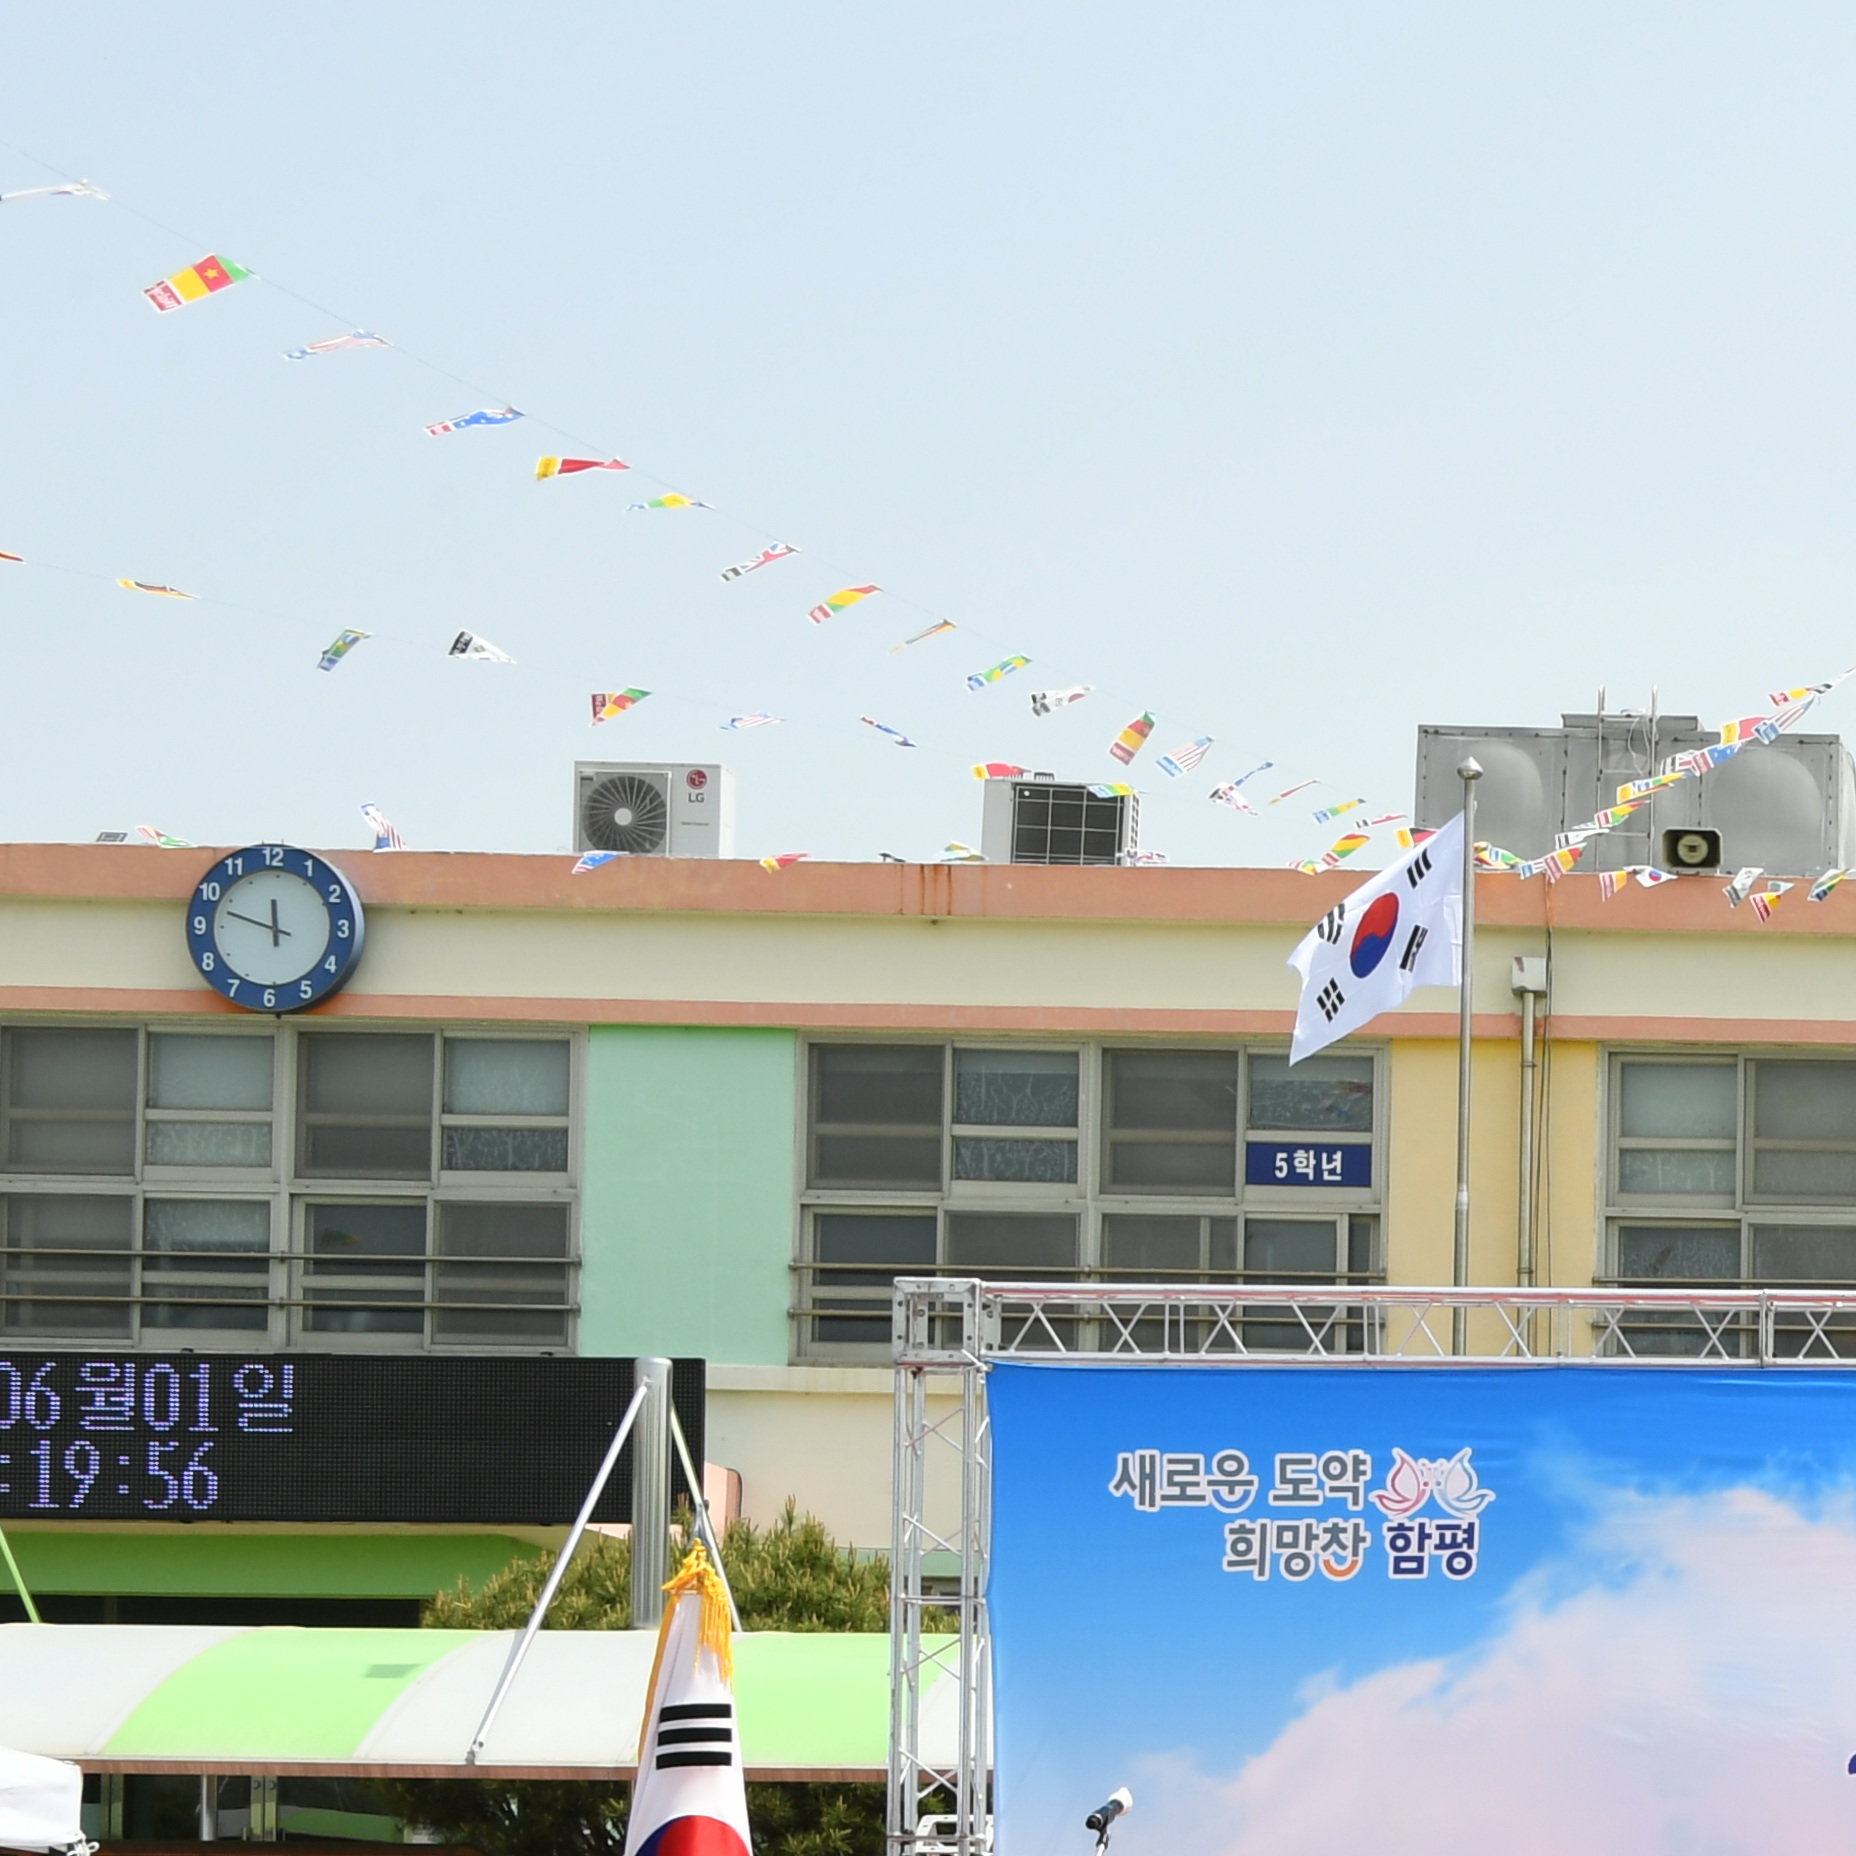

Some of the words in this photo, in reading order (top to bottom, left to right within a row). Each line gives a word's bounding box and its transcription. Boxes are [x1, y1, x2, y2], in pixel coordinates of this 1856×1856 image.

[688, 793, 704, 803] LG
[225, 858, 243, 875] 11
[263, 848, 284, 866] 12
[304, 859, 313, 877] 1
[199, 882, 220, 901] 10
[329, 885, 341, 903] 2
[194, 916, 206, 935] 9
[337, 919, 350, 938] 3
[202, 952, 214, 971] 8
[324, 955, 337, 973] 4
[227, 979, 240, 998] 7
[263, 989, 276, 1007] 6
[300, 980, 312, 999] 5
[1274, 1150, 1342, 1180] 5학년
[1113, 1454, 1255, 1508] 새로운
[1272, 1454, 1367, 1506] 도약
[1227, 1522, 1366, 1578] 희망찬
[1386, 1521, 1476, 1577] 함평
